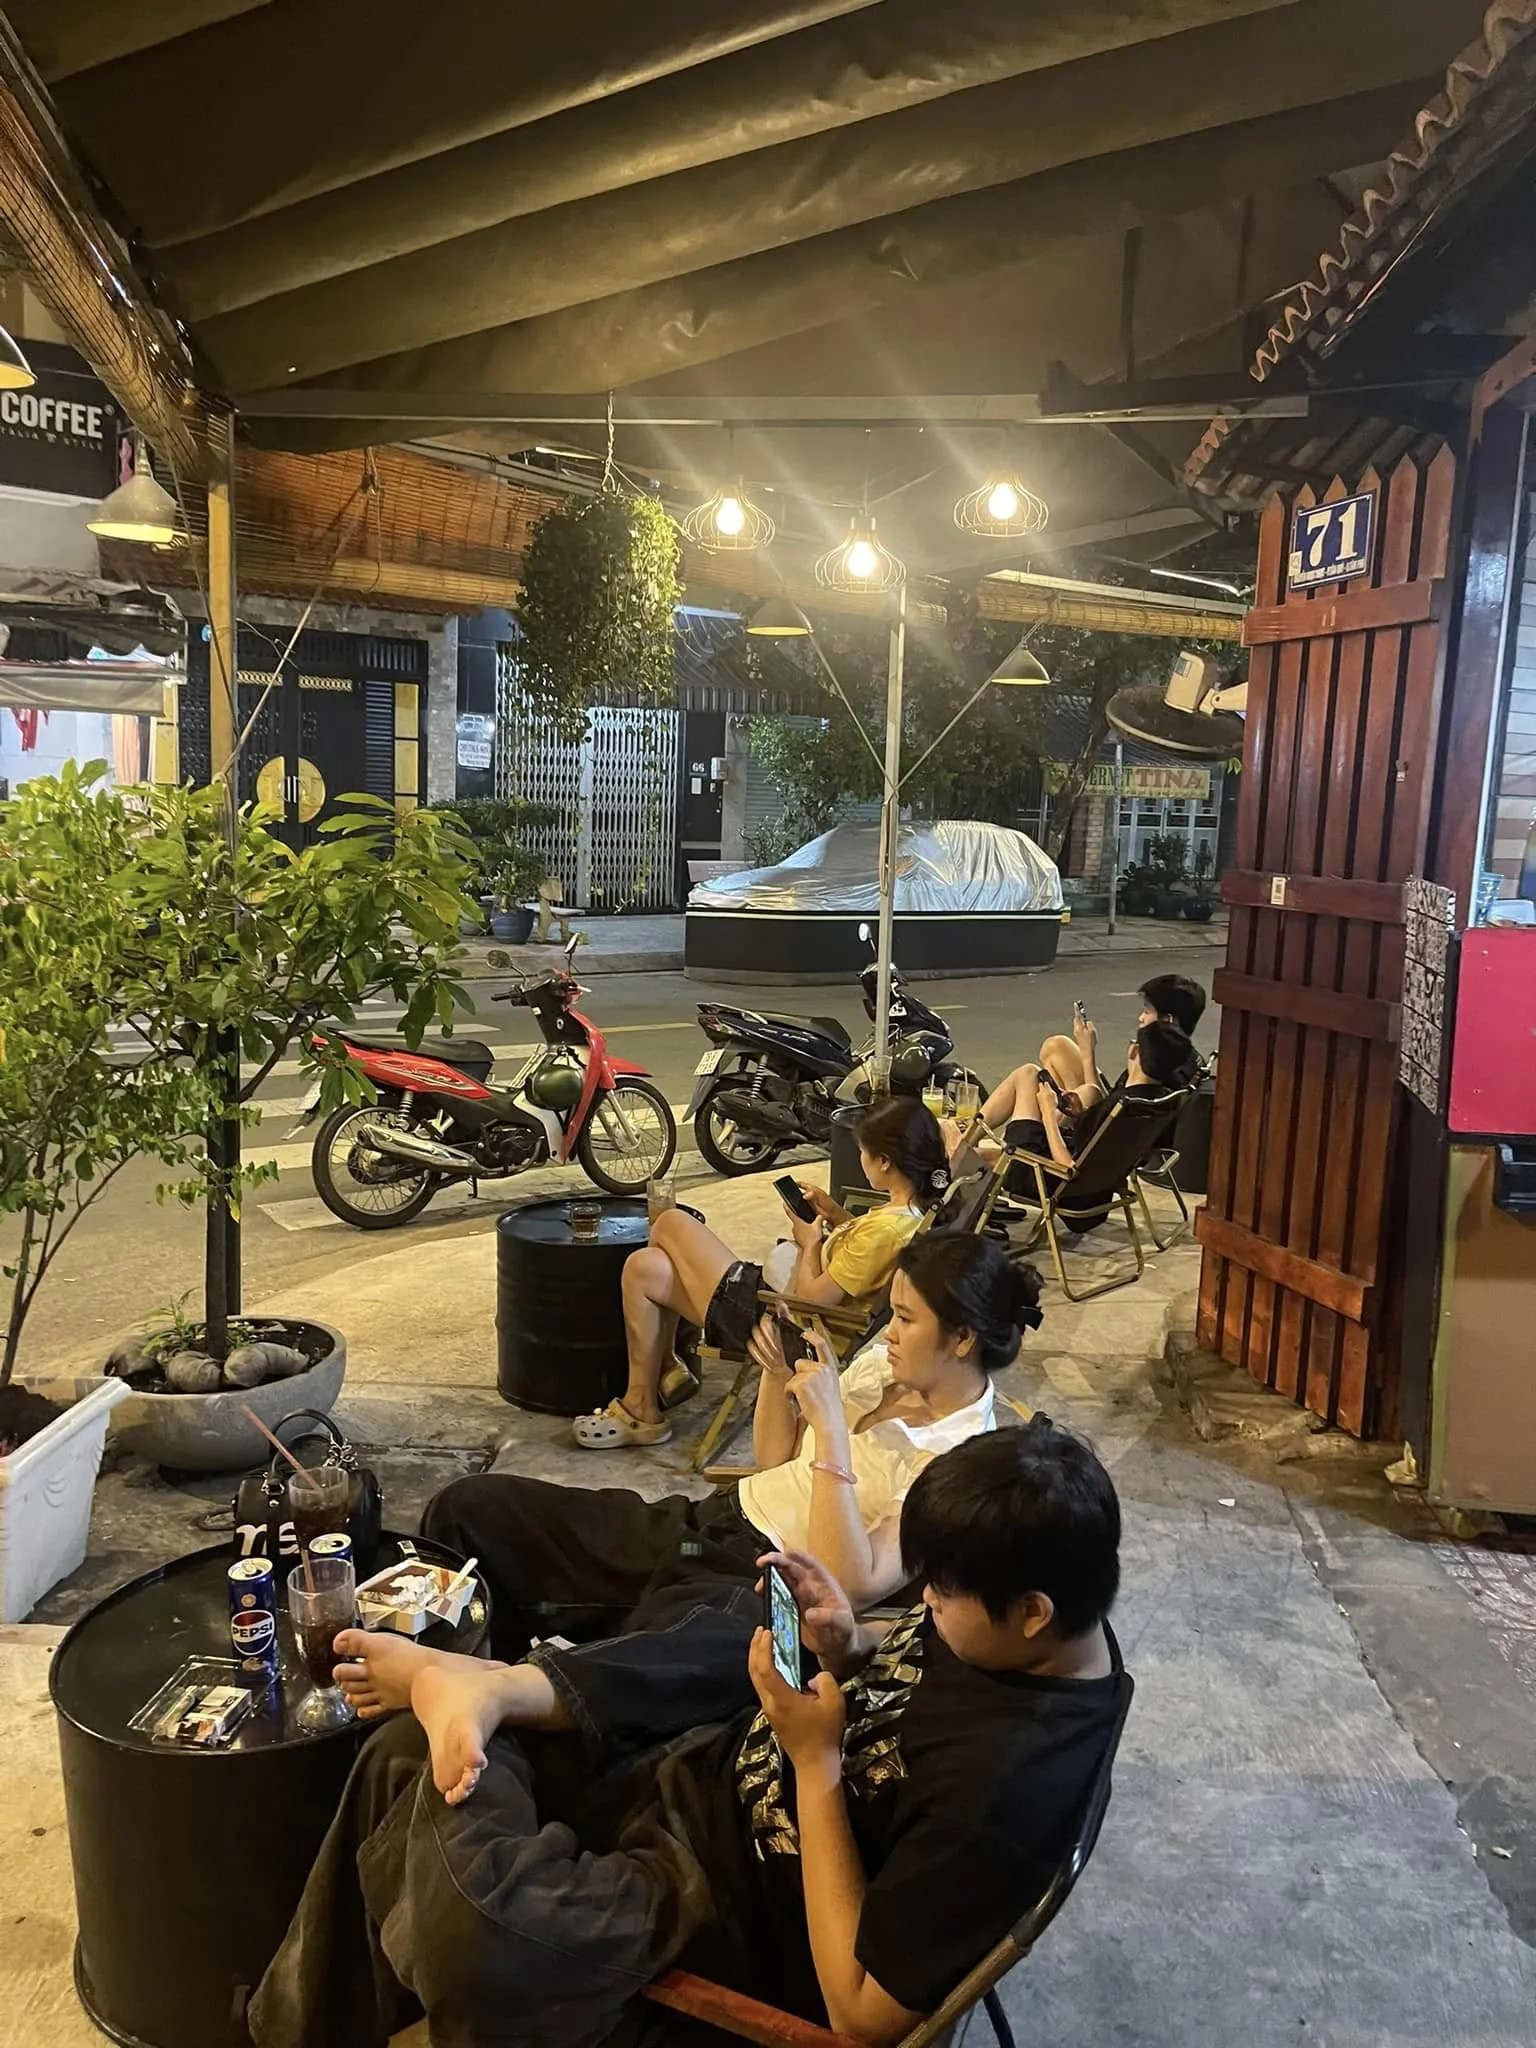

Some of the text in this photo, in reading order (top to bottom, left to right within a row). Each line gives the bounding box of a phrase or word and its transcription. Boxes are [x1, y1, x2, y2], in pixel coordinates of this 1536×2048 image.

[1, 391, 103, 439] COFFEE
[1306, 501, 1358, 567] 71
[232, 1621, 273, 1638] PEPSI
